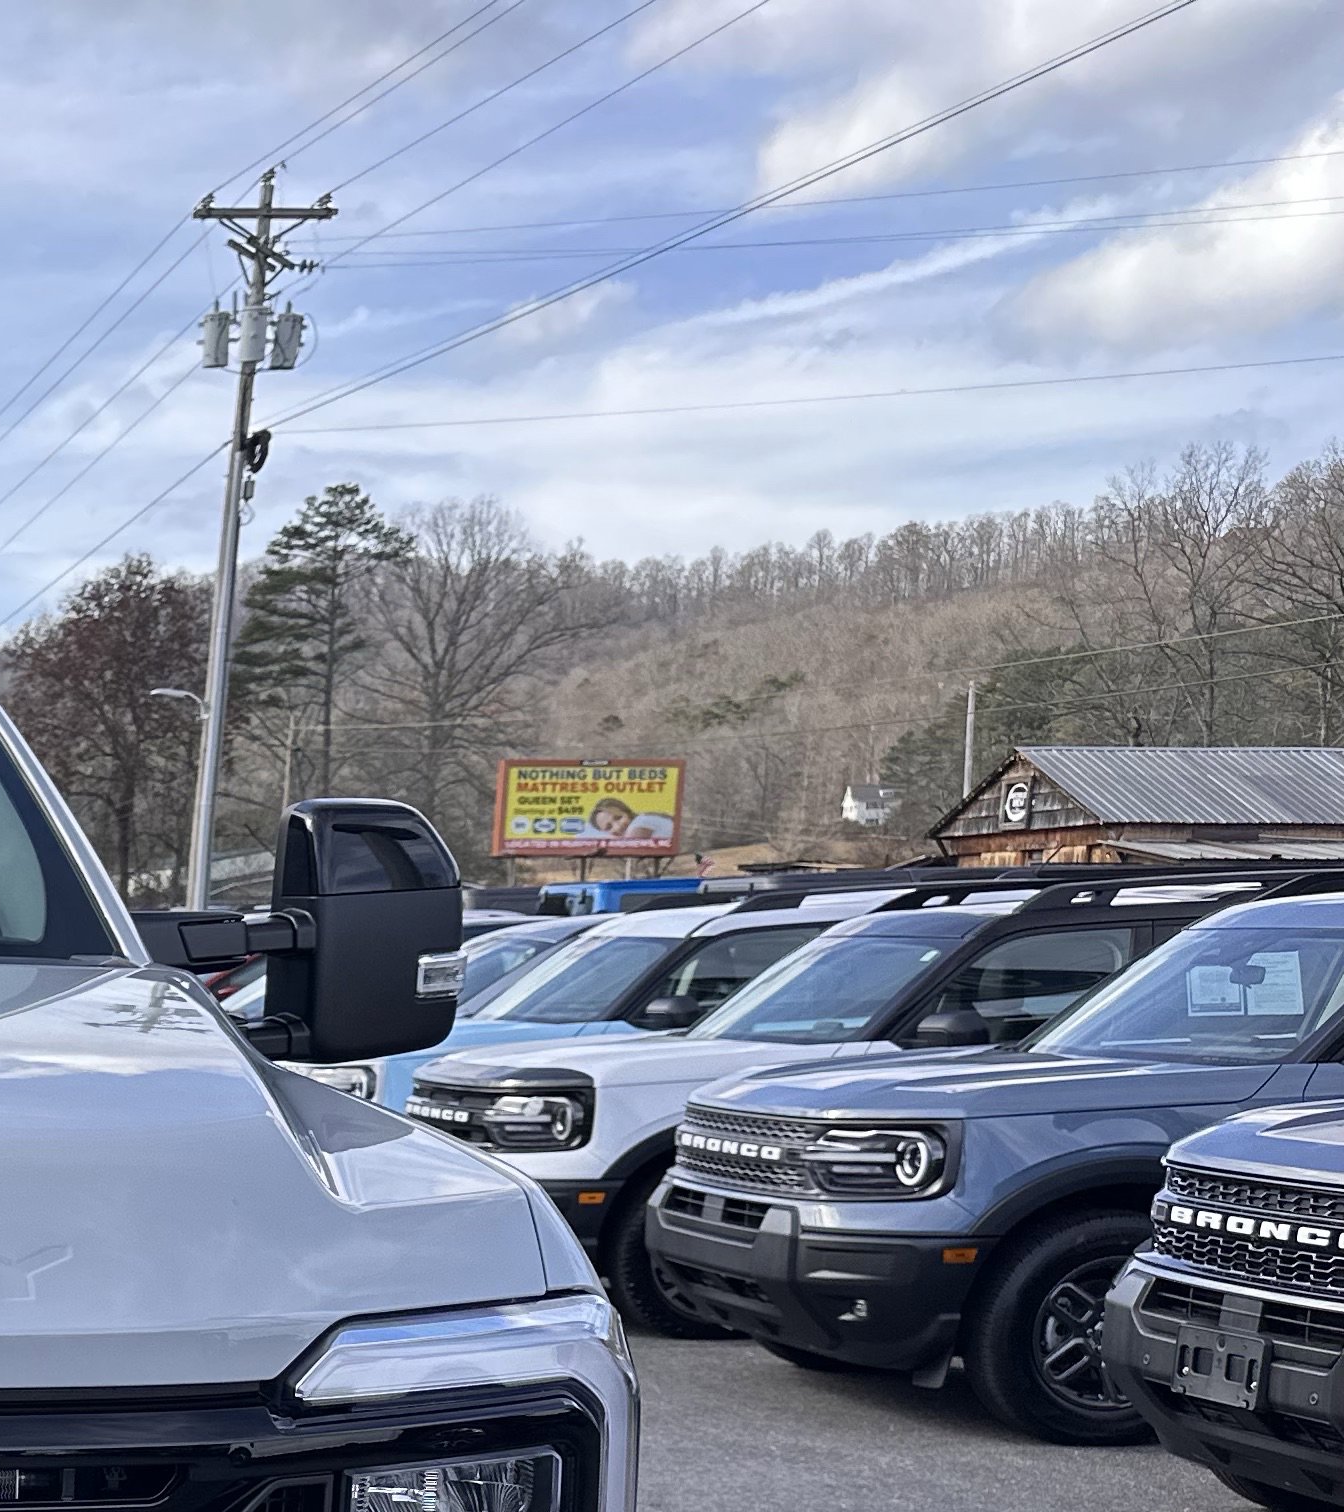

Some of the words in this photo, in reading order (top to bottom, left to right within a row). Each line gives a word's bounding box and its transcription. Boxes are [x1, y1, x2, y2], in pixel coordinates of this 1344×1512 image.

[518, 768, 588, 780] NOTHING
[592, 768, 624, 780] BUT
[628, 768, 668, 780] BEDS
[516, 782, 600, 793] MATTRESS
[604, 782, 667, 793] OUTLET
[517, 796, 558, 806] QUEEN
[560, 796, 582, 806] SET
[680, 1133, 781, 1160] BRONCO
[1170, 1205, 1344, 1250] BRONC
